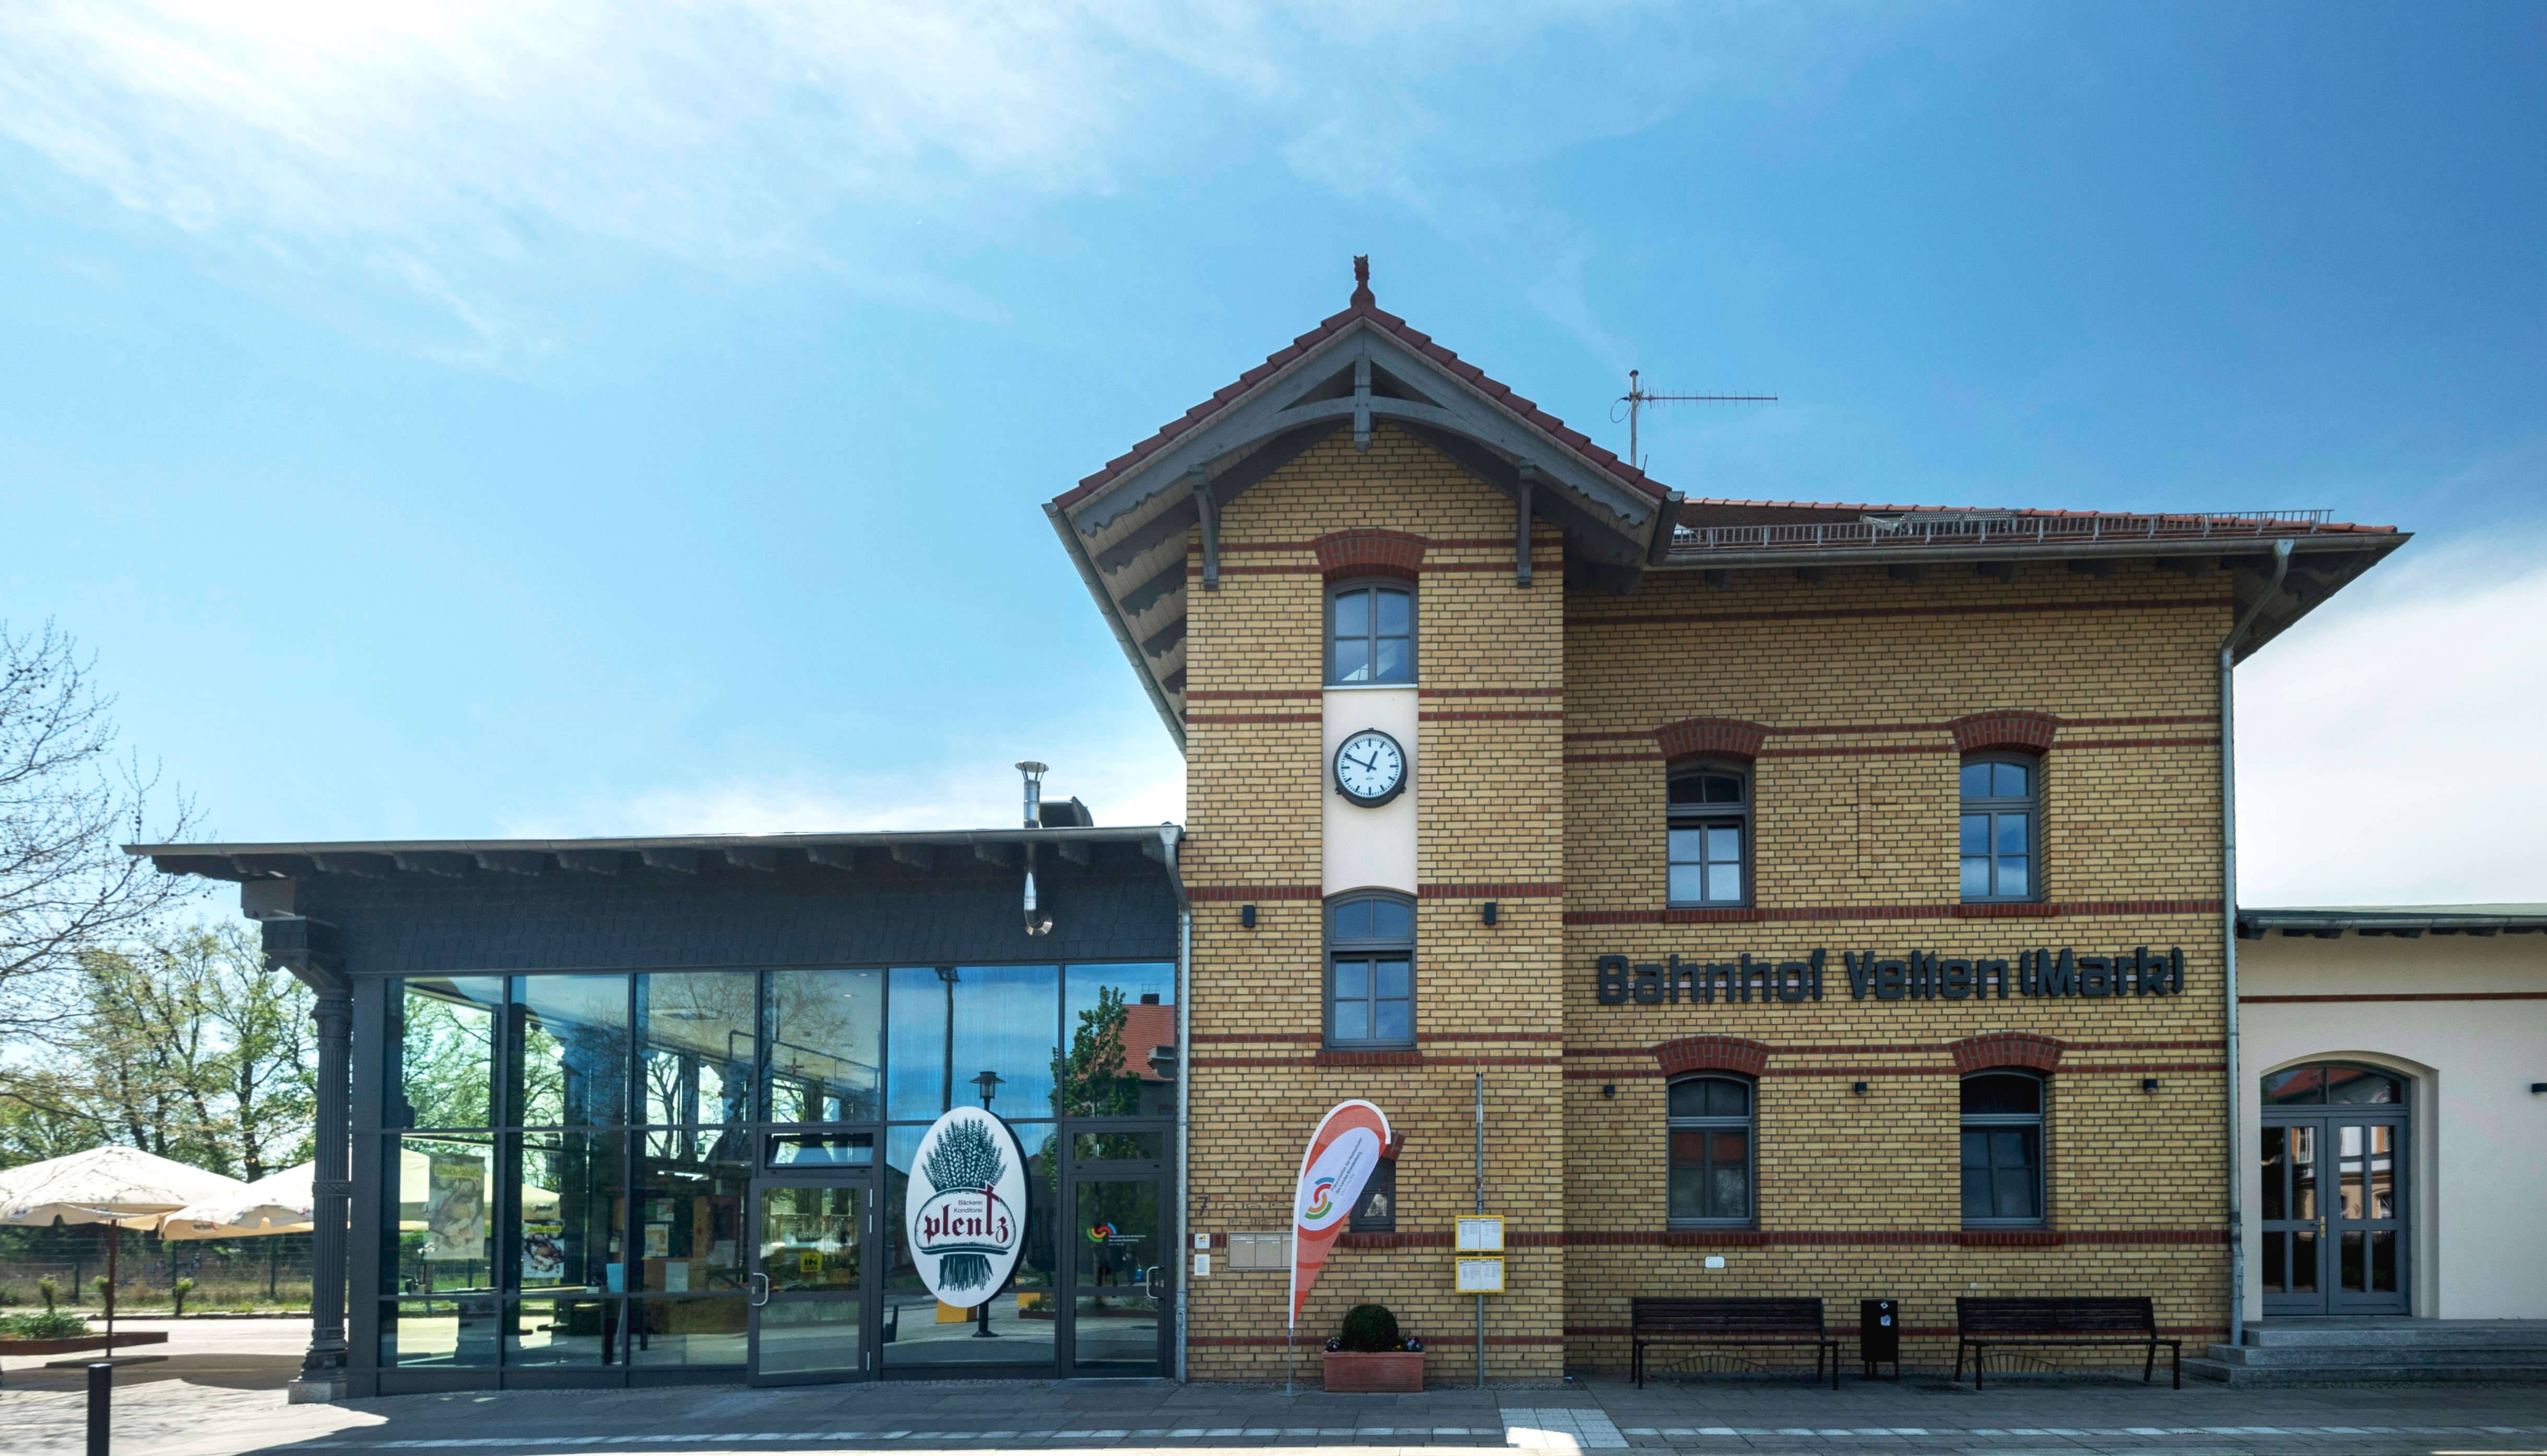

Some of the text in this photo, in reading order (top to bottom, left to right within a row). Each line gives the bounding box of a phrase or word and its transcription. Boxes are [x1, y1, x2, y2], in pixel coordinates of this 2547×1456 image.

[1599, 946, 2184, 1003] Bahnhof Velten (Mark)
[923, 1183, 1009, 1245] plentz
